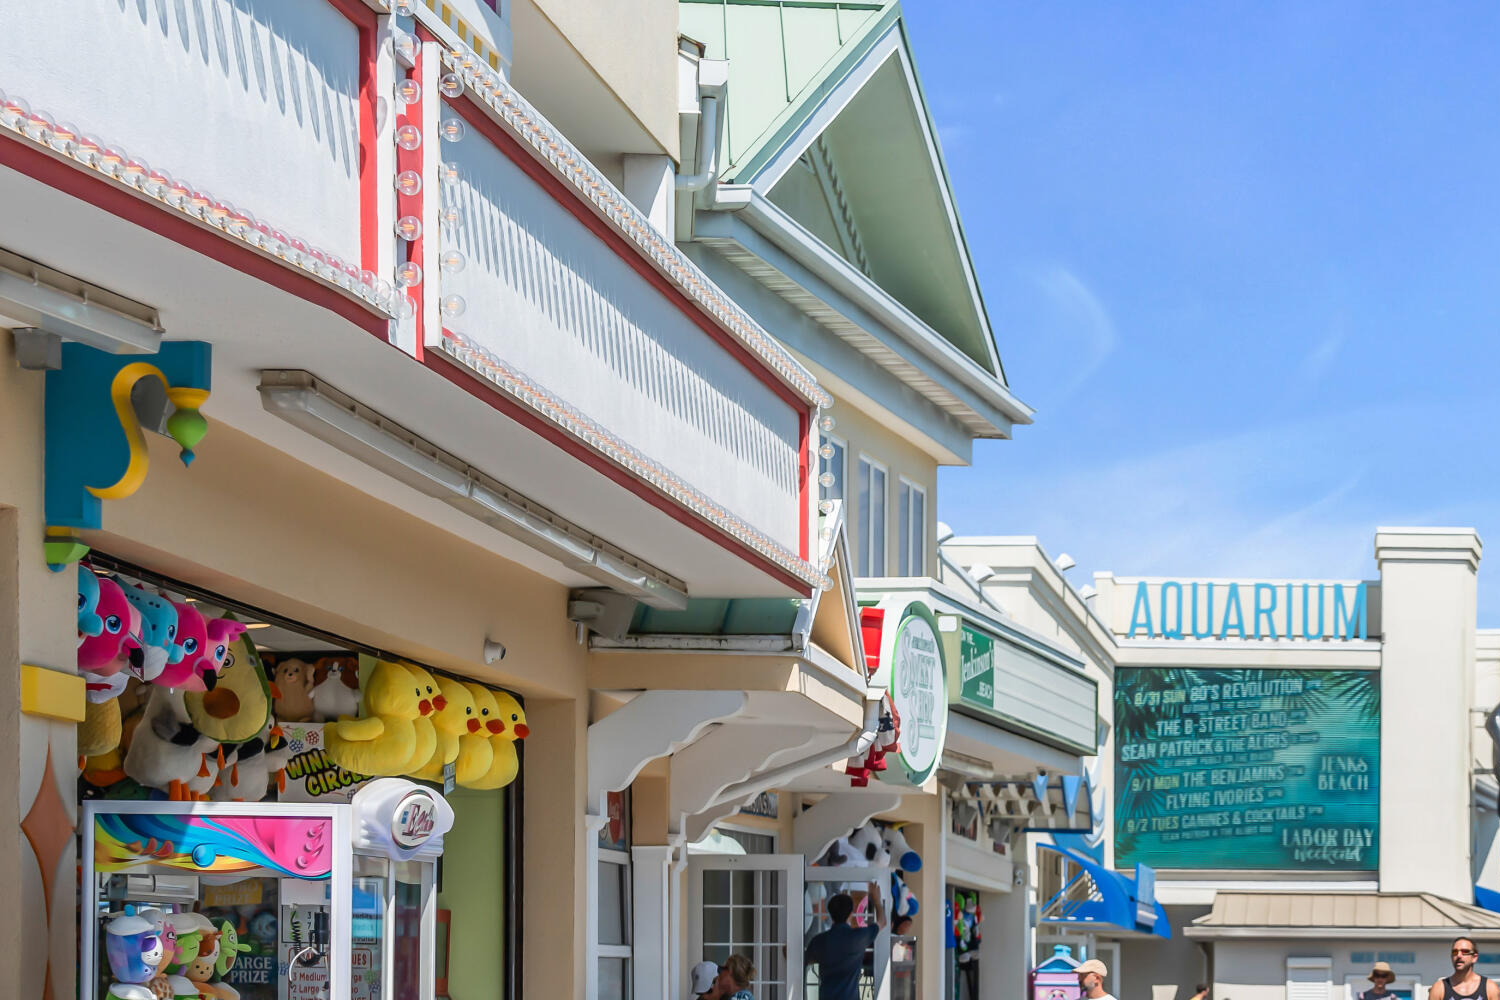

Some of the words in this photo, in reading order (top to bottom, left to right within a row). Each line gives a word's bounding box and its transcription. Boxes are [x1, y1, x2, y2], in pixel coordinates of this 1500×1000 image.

[1127, 580, 1368, 641] AQUARIUM
[1222, 679, 1304, 699] REVOLUTION
[1156, 718, 1181, 737] THE
[1184, 713, 1248, 735] B-STREET
[1251, 711, 1288, 729] BAND
[1121, 743, 1156, 762] SEAN
[1159, 738, 1214, 758] PATRICK
[1225, 735, 1249, 752] THE
[1249, 731, 1289, 750] ALIBIS
[1131, 777, 1152, 792] 9/1
[1153, 775, 1180, 790] MON
[1182, 771, 1207, 787] THE
[1210, 765, 1285, 785] BENJAMINS
[1318, 774, 1369, 790] BEACH
[1166, 792, 1211, 810] FLYING
[1213, 787, 1265, 806] IVORIES
[1127, 819, 1148, 833] 9/2
[1152, 816, 1180, 831] TUES
[1244, 806, 1306, 823] COCKTAILS
[1282, 828, 1339, 847] LABOR
[1343, 828, 1374, 847] DAY
[232, 957, 272, 970] ARGE
